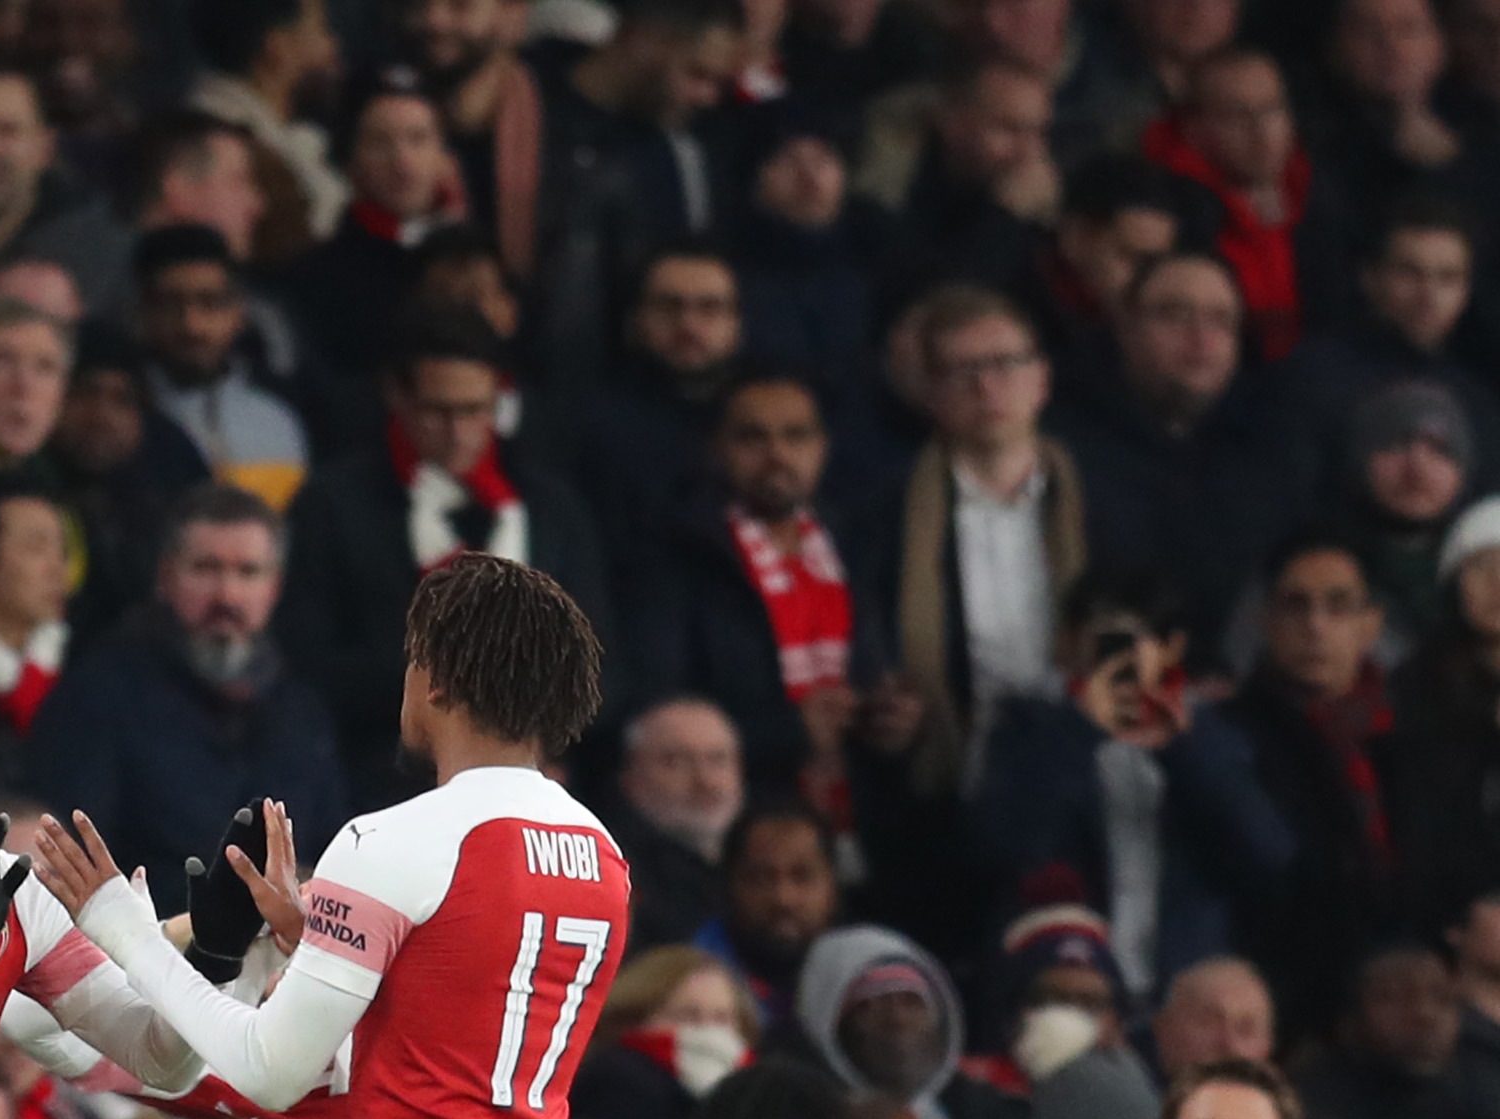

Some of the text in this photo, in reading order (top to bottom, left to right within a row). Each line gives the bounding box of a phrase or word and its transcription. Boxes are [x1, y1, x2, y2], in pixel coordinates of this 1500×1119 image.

[522, 827, 602, 883] IWOBI
[311, 893, 352, 921] VISIT
[490, 911, 611, 1110] 17
